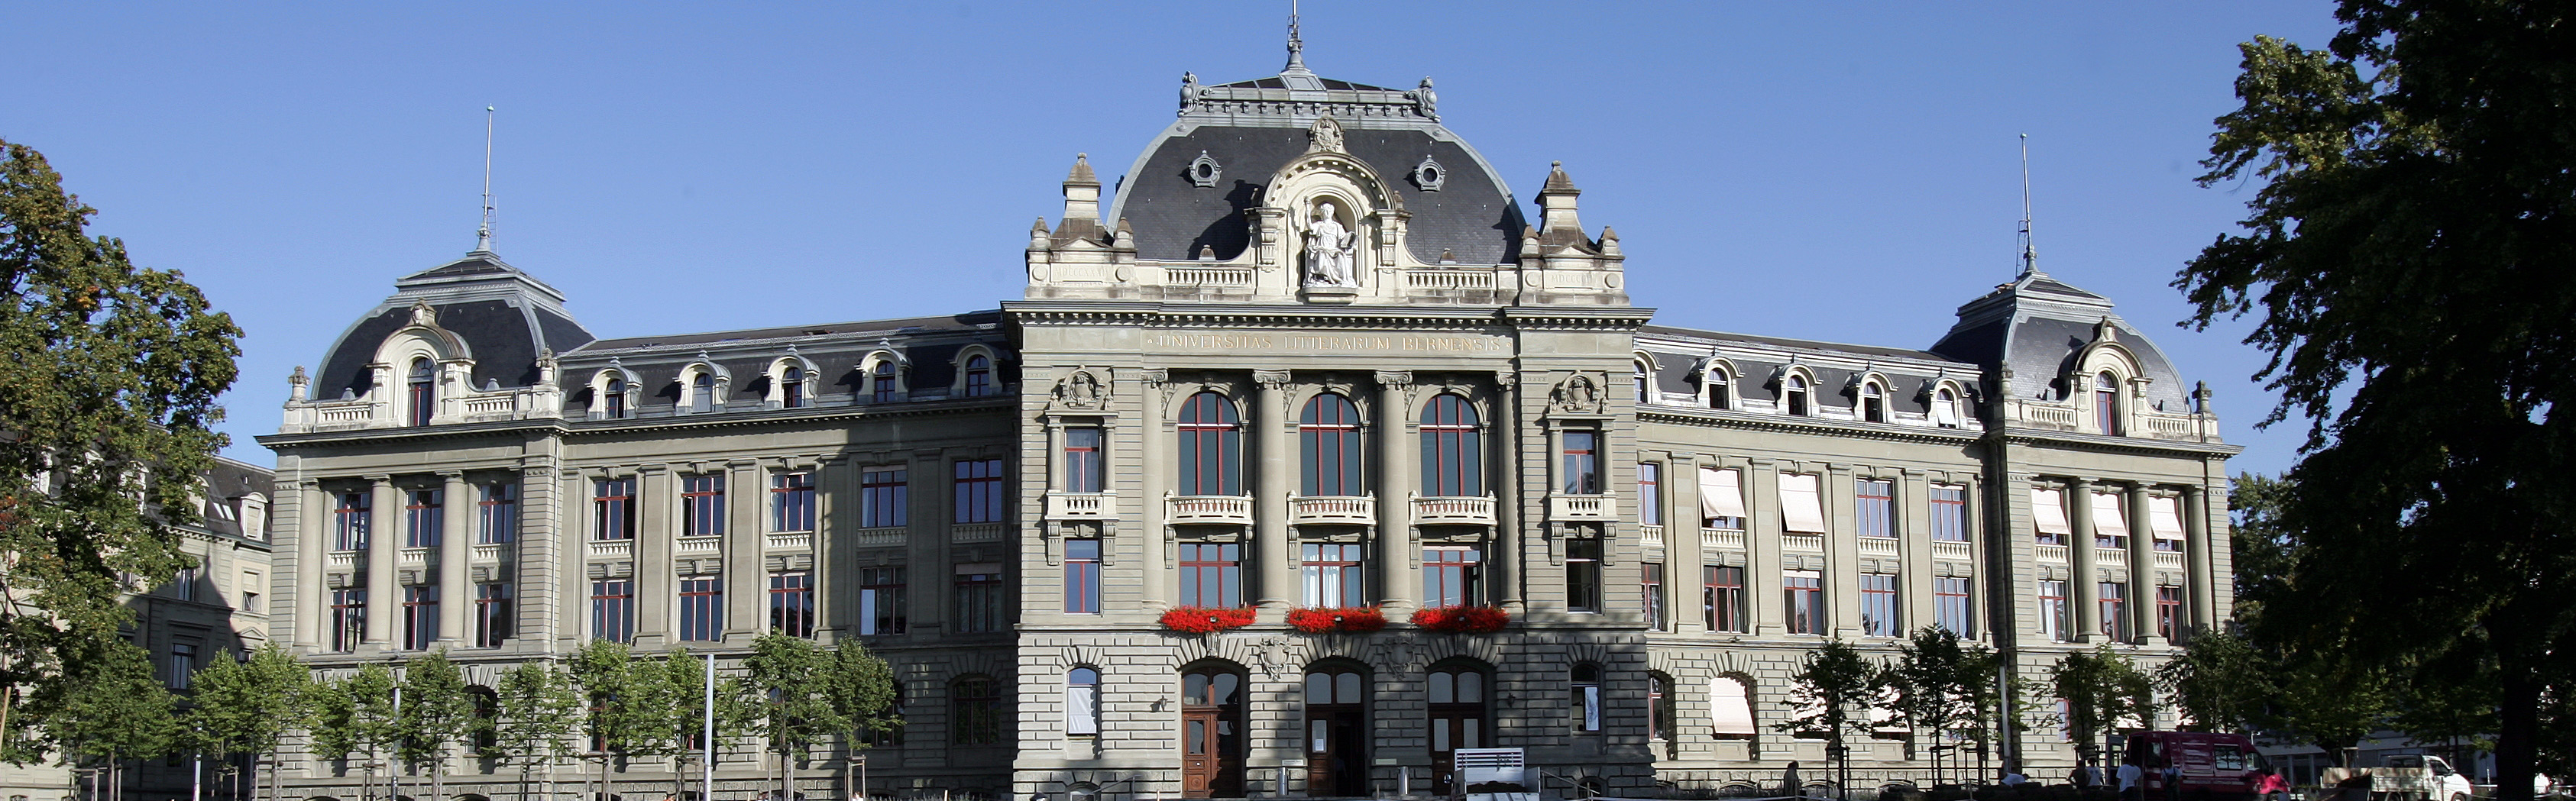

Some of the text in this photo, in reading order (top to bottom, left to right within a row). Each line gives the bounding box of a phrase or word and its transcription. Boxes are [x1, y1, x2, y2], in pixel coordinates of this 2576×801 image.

[1159, 334, 1500, 351] UNIVERSITAS LITTERARUM BERNENSIS
